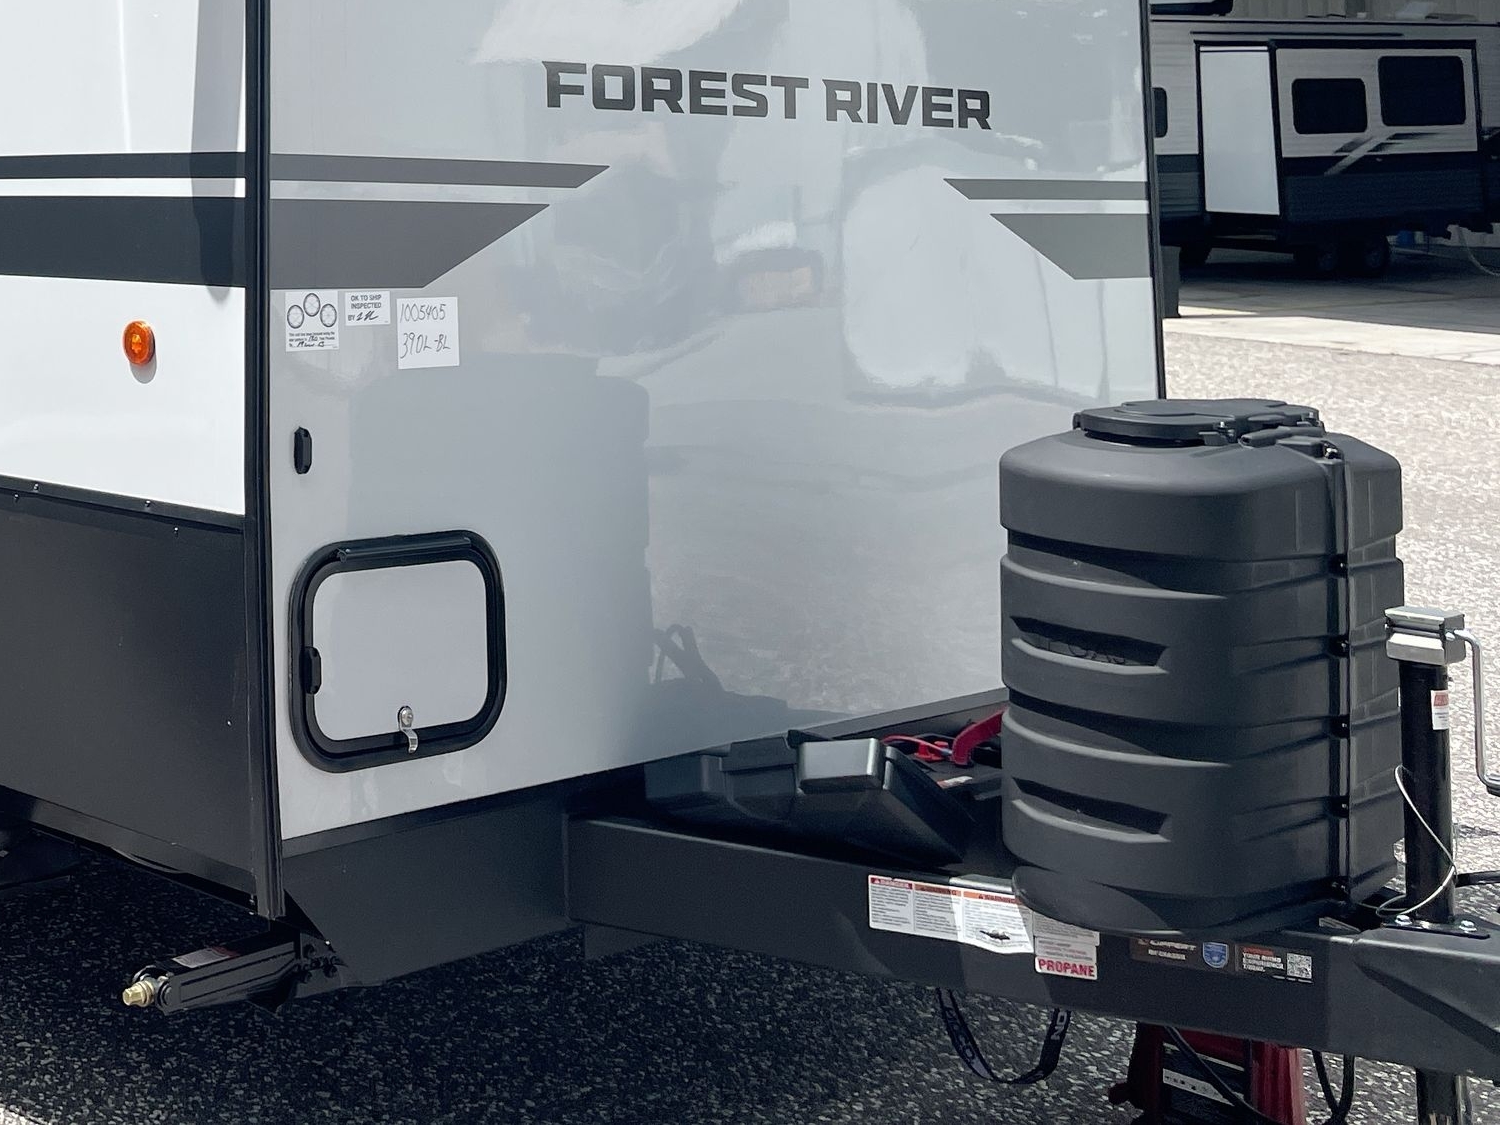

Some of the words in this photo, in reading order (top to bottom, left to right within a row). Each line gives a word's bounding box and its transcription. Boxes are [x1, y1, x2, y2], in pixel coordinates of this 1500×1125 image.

[541, 60, 810, 120] FOREST
[821, 77, 993, 131] RIVER
[350, 294, 359, 302] OK
[360, 294, 369, 302] TO
[369, 293, 382, 301] SHIP
[350, 301, 382, 310] INSPECTED
[1038, 958, 1096, 978] PROPANE
